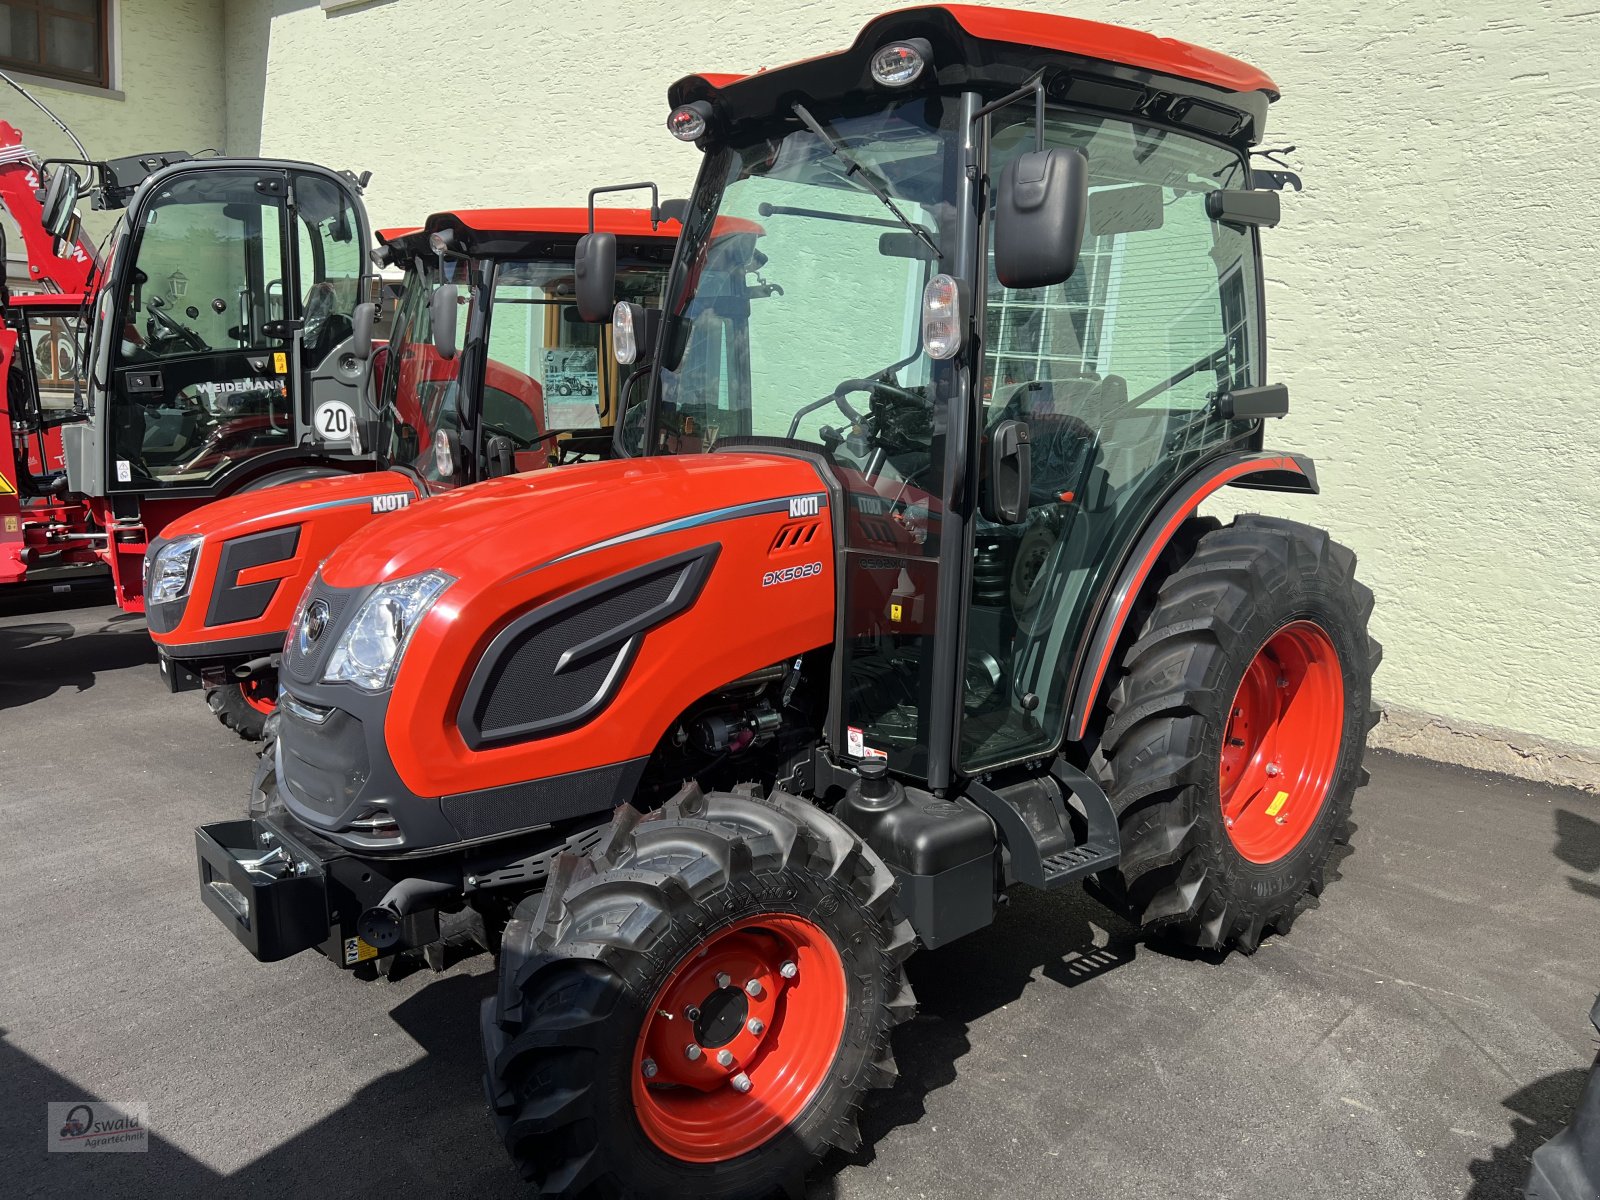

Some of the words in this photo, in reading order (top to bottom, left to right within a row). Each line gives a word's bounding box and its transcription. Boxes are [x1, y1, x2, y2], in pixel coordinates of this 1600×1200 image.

[196, 380, 285, 394] WEIDEMANN
[323, 408, 348, 433] 20
[372, 493, 409, 513] KIOTI
[789, 496, 819, 517] KIOTI
[763, 561, 823, 588] DK5020
